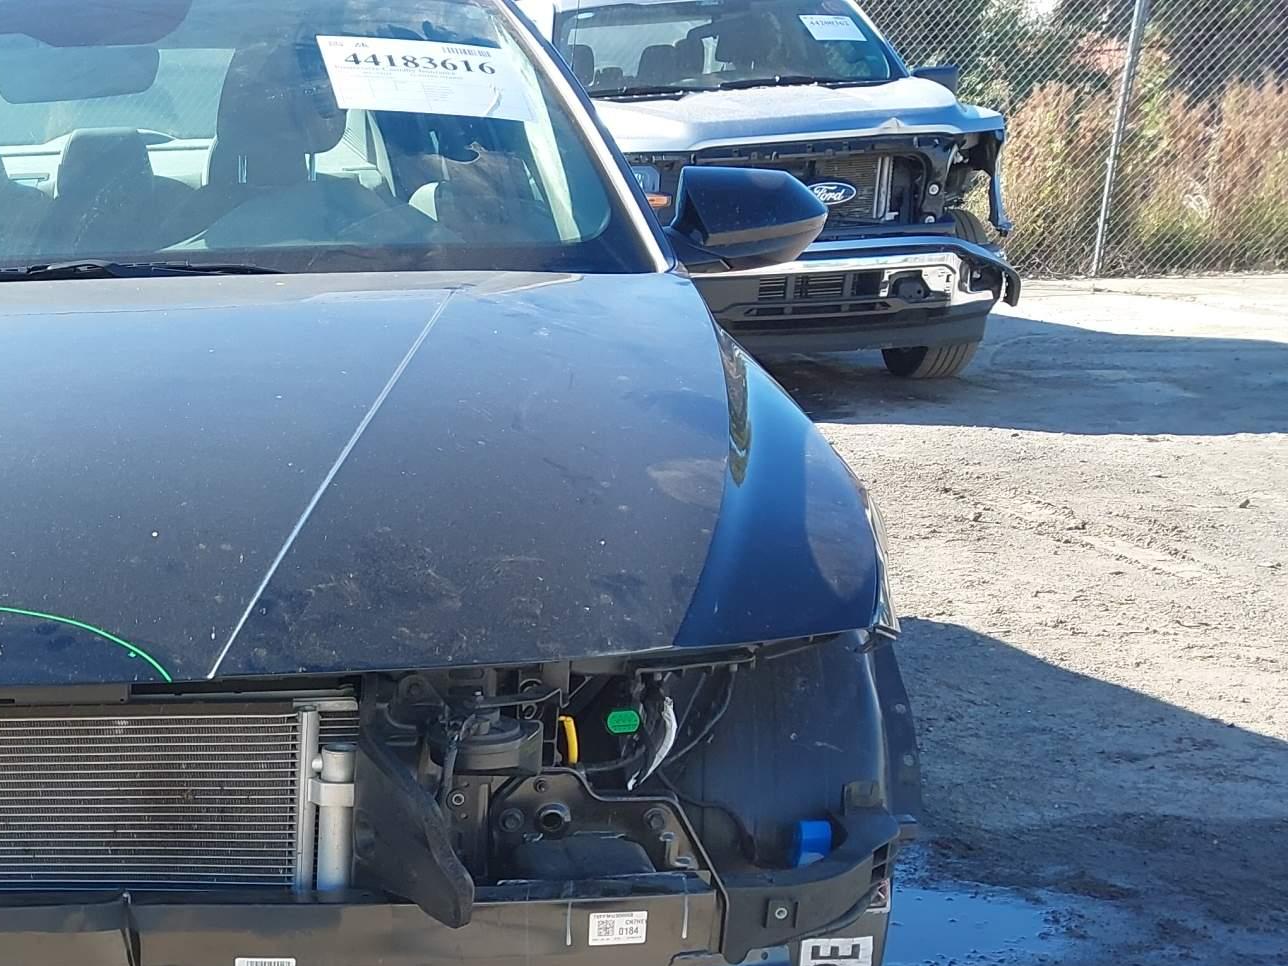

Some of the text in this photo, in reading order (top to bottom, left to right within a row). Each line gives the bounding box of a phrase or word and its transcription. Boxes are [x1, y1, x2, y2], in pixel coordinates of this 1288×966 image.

[344, 52, 496, 75] 44183616
[813, 185, 846, 202] Ford
[618, 927, 639, 936] 0184
